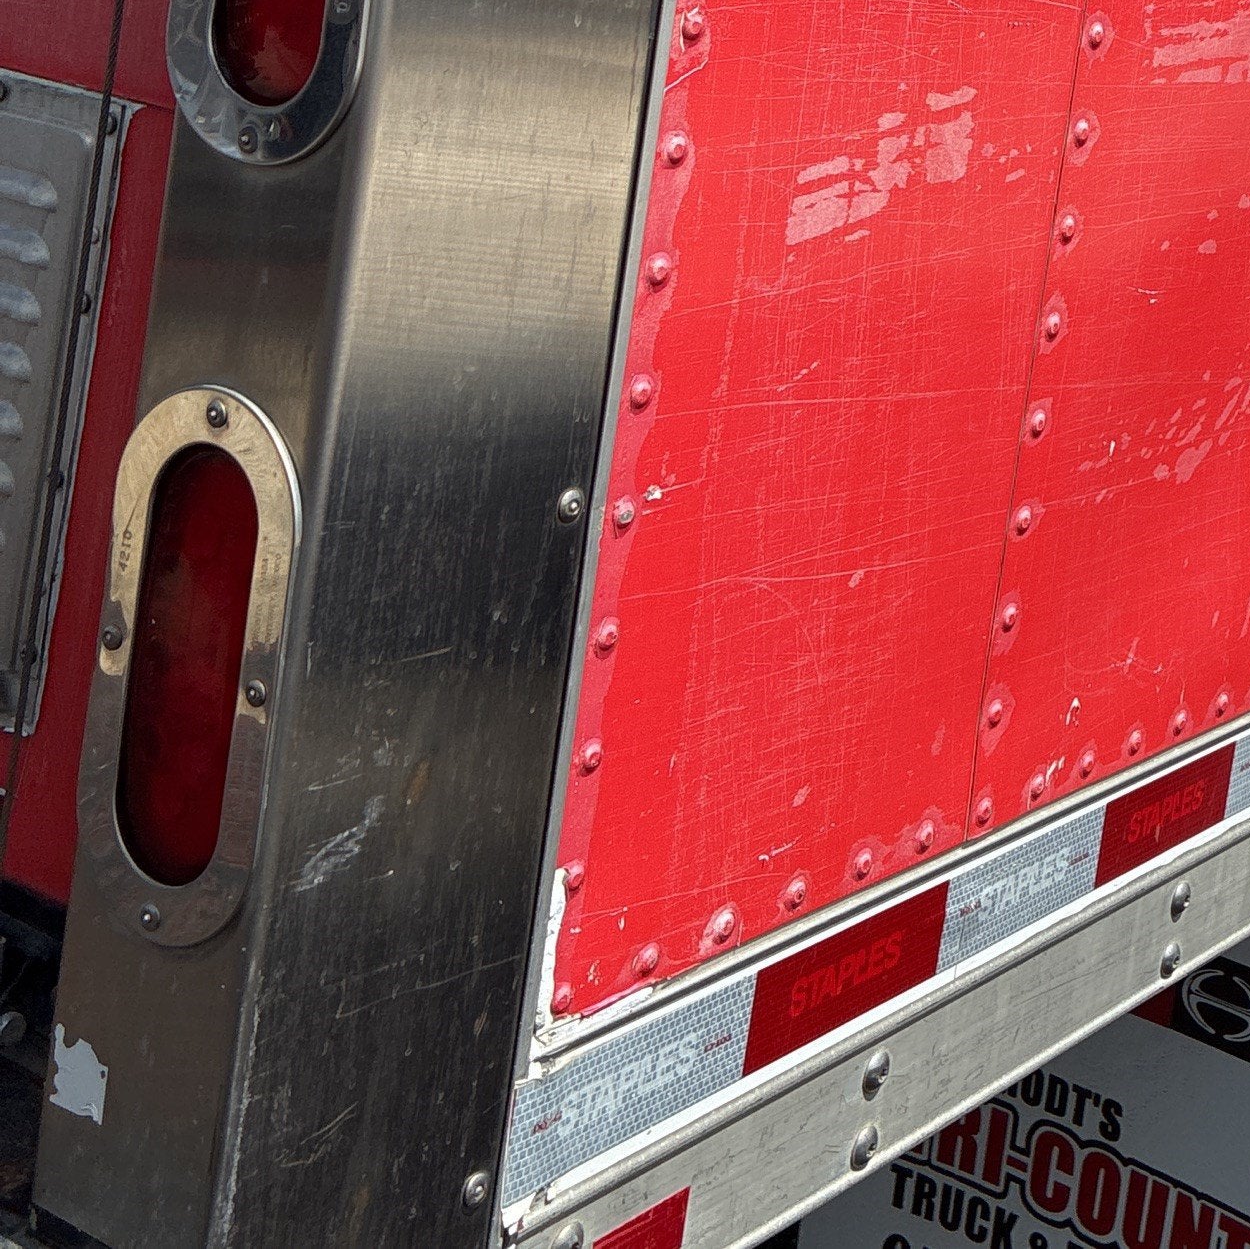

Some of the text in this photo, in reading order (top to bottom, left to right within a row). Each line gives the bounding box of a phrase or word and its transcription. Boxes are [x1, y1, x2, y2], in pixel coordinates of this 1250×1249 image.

[1126, 782, 1203, 843] STAPLES
[978, 848, 1070, 920] STAPLES
[789, 933, 901, 1018] STAPLES
[1002, 1068, 1123, 1143] ODT'S
[890, 1163, 1020, 1249] TRUCK
